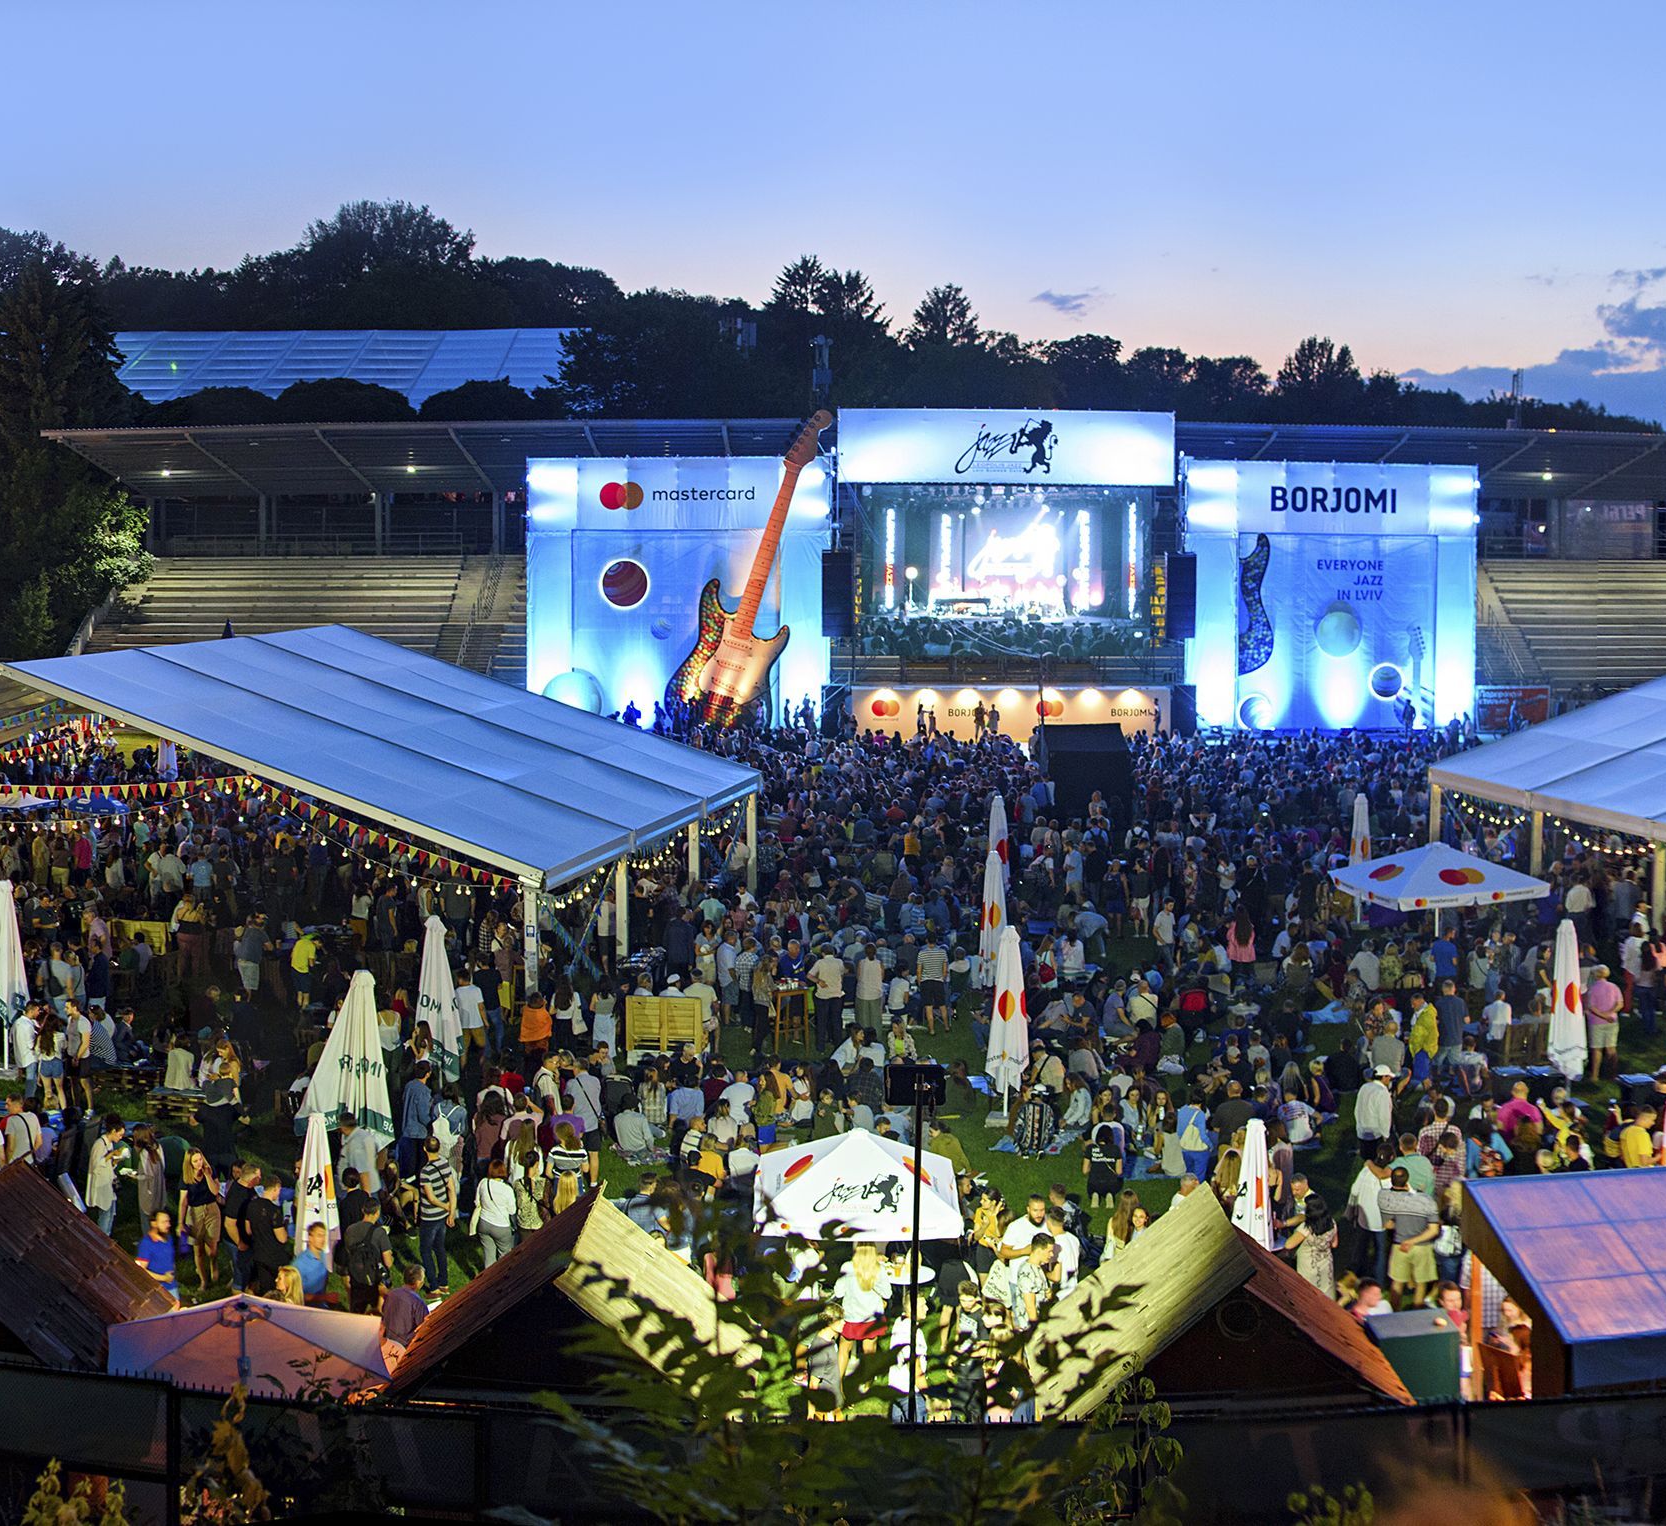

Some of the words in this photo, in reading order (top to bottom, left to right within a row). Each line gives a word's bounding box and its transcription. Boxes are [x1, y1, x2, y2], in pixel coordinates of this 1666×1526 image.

[652, 486, 755, 501] mastercard
[1270, 485, 1397, 514] BORJOMI
[1316, 558, 1384, 571] EVERYONE
[1353, 575, 1384, 586] JAZZ
[1337, 589, 1351, 600] IN
[1355, 589, 1384, 601] LVIV
[1110, 708, 1150, 717] BORJOMI
[813, 1177, 862, 1213] jazz
